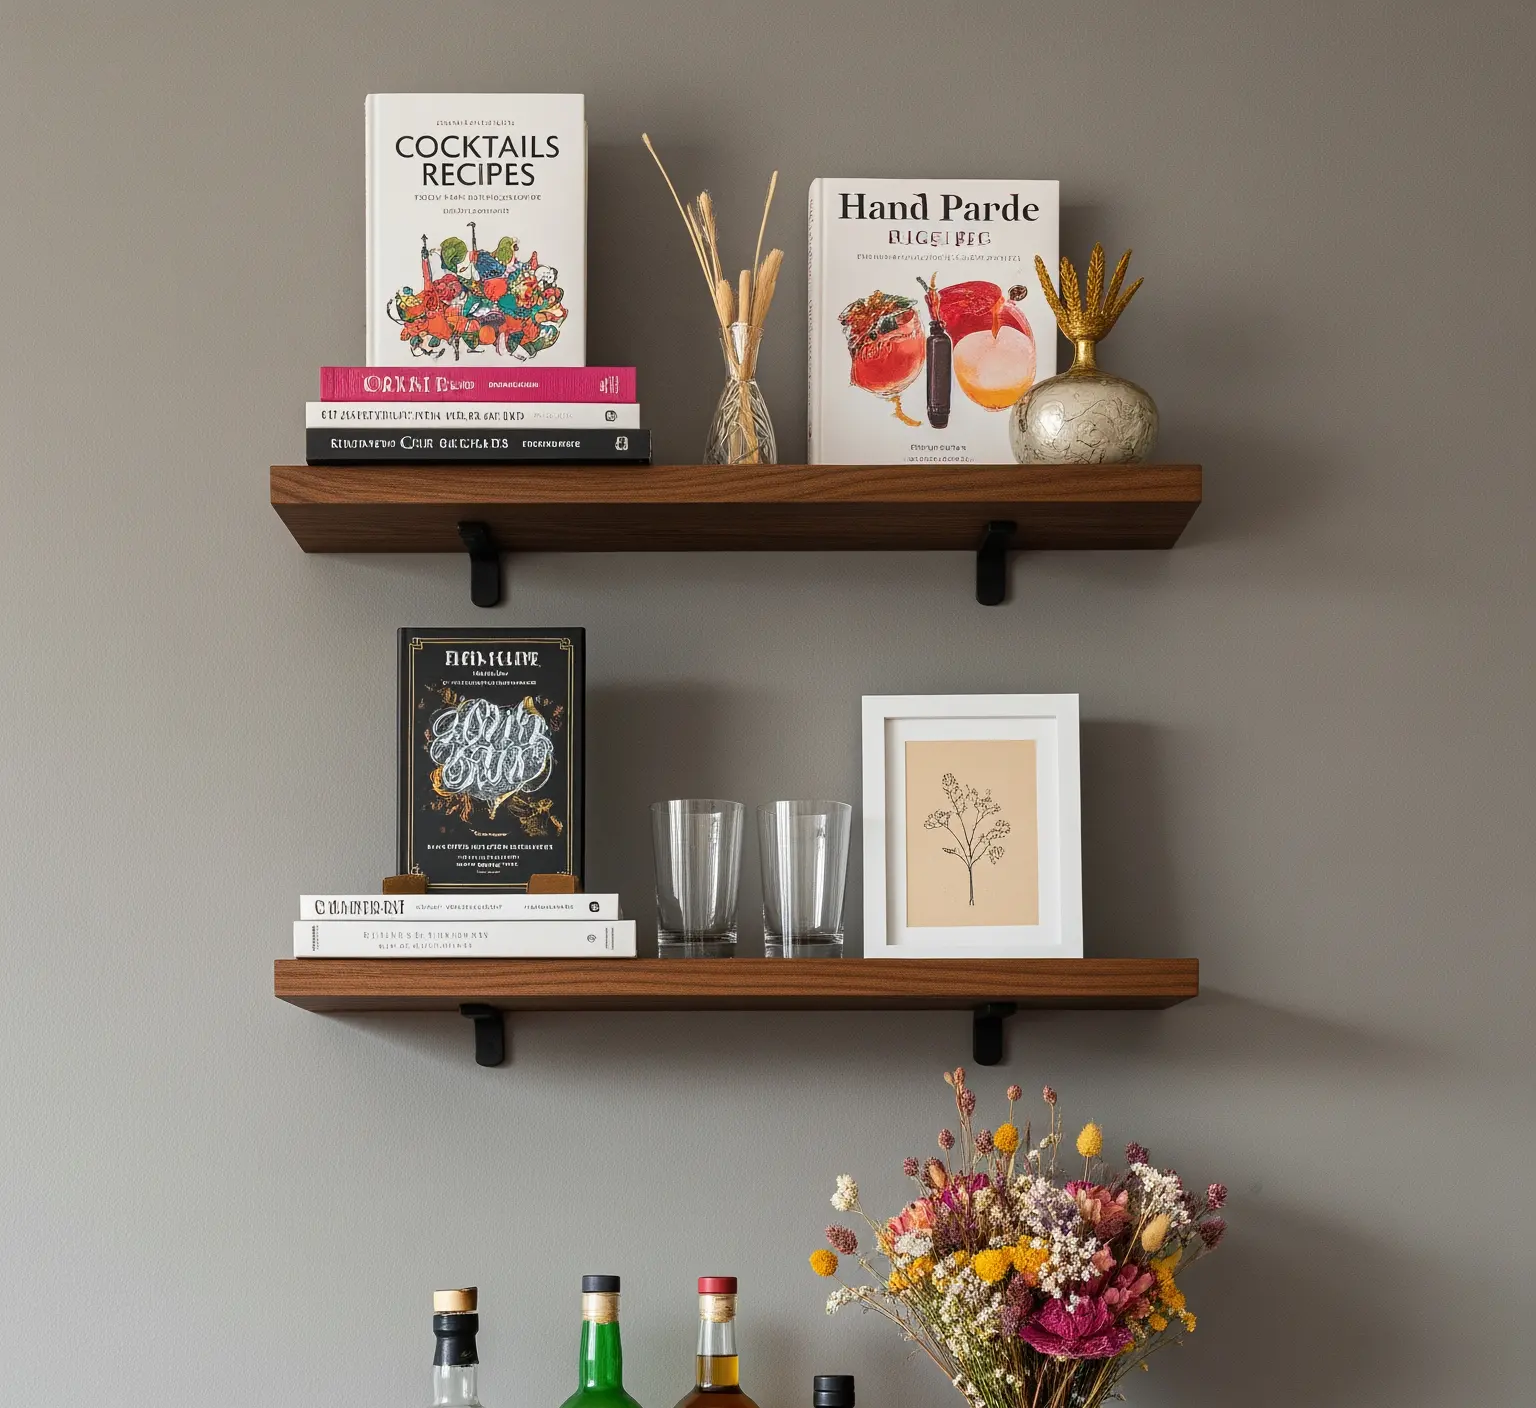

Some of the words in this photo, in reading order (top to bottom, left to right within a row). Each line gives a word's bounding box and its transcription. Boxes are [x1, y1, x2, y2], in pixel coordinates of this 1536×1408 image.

[395, 135, 560, 159] COCKTAILS
[422, 162, 535, 187] RECIPES
[838, 192, 930, 221] Hand
[939, 193, 1040, 222] Parde
